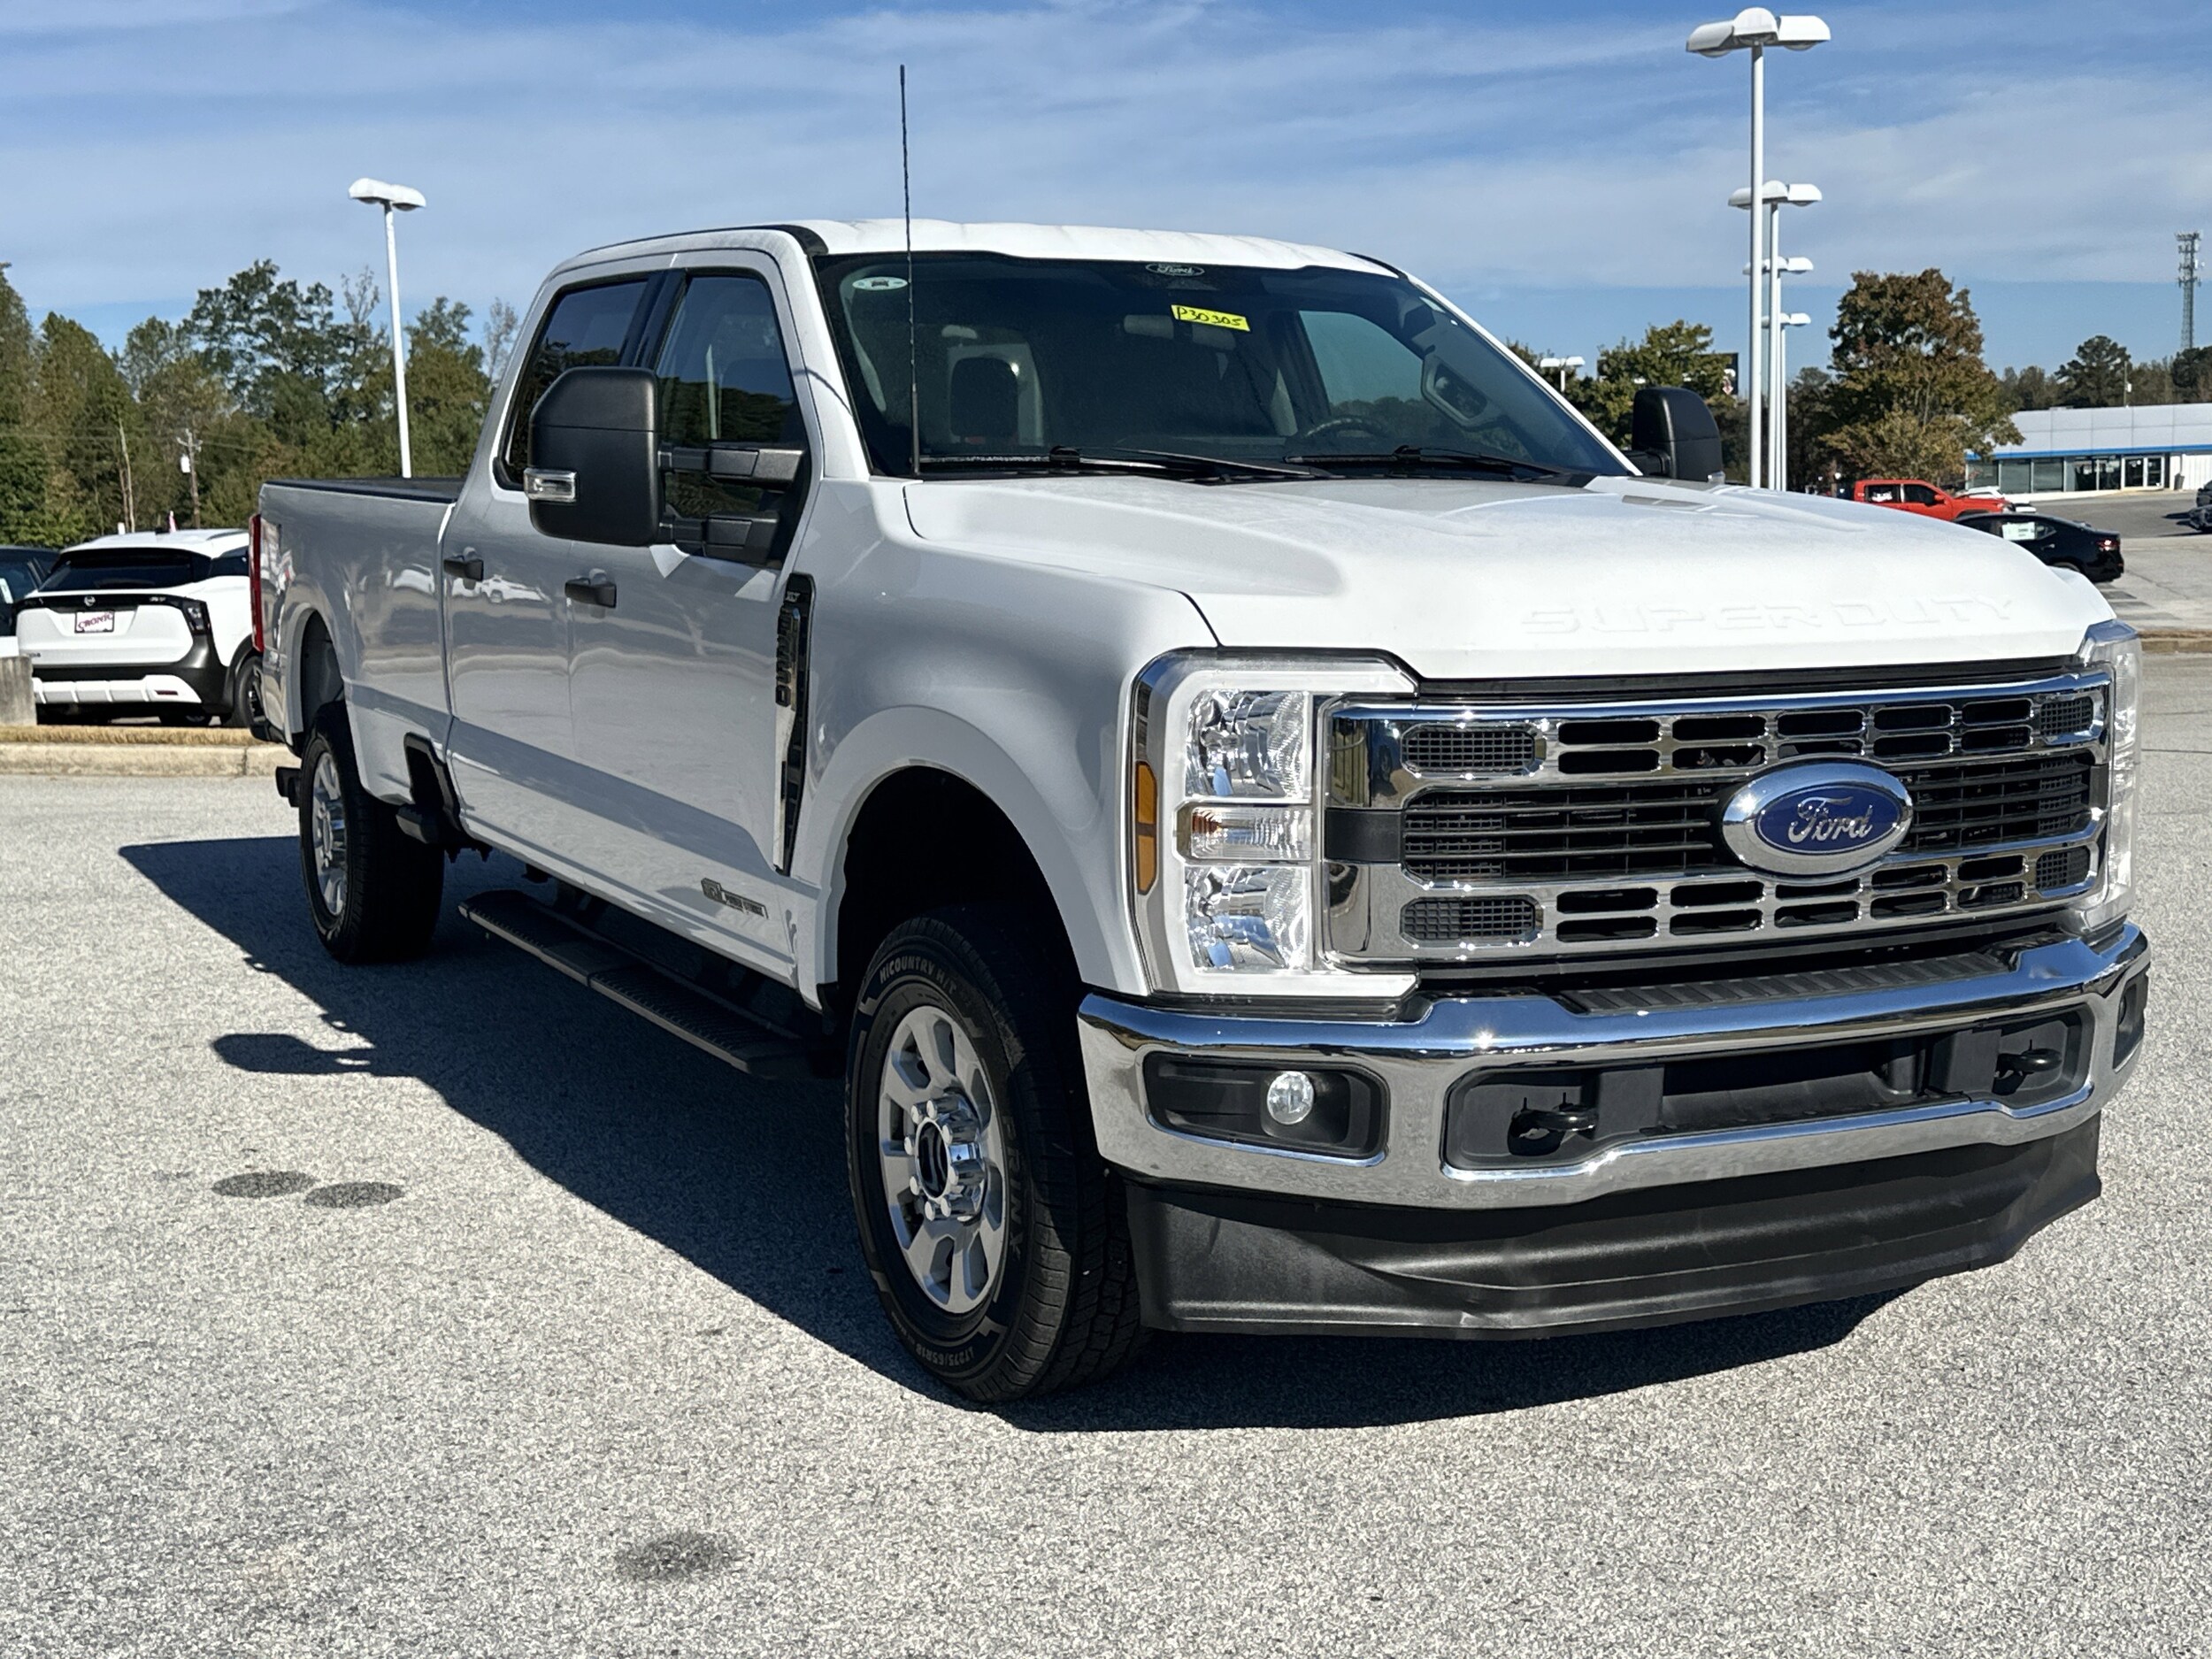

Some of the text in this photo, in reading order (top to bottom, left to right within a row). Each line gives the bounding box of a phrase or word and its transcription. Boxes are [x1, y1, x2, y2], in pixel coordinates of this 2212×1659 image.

[1156, 265, 1194, 274] Ford
[1176, 306, 1242, 326] P30305
[1521, 595, 2012, 634] SUPER DUTY
[1788, 796, 1873, 843] Ford
[1002, 1116, 1023, 1261] PRINX
